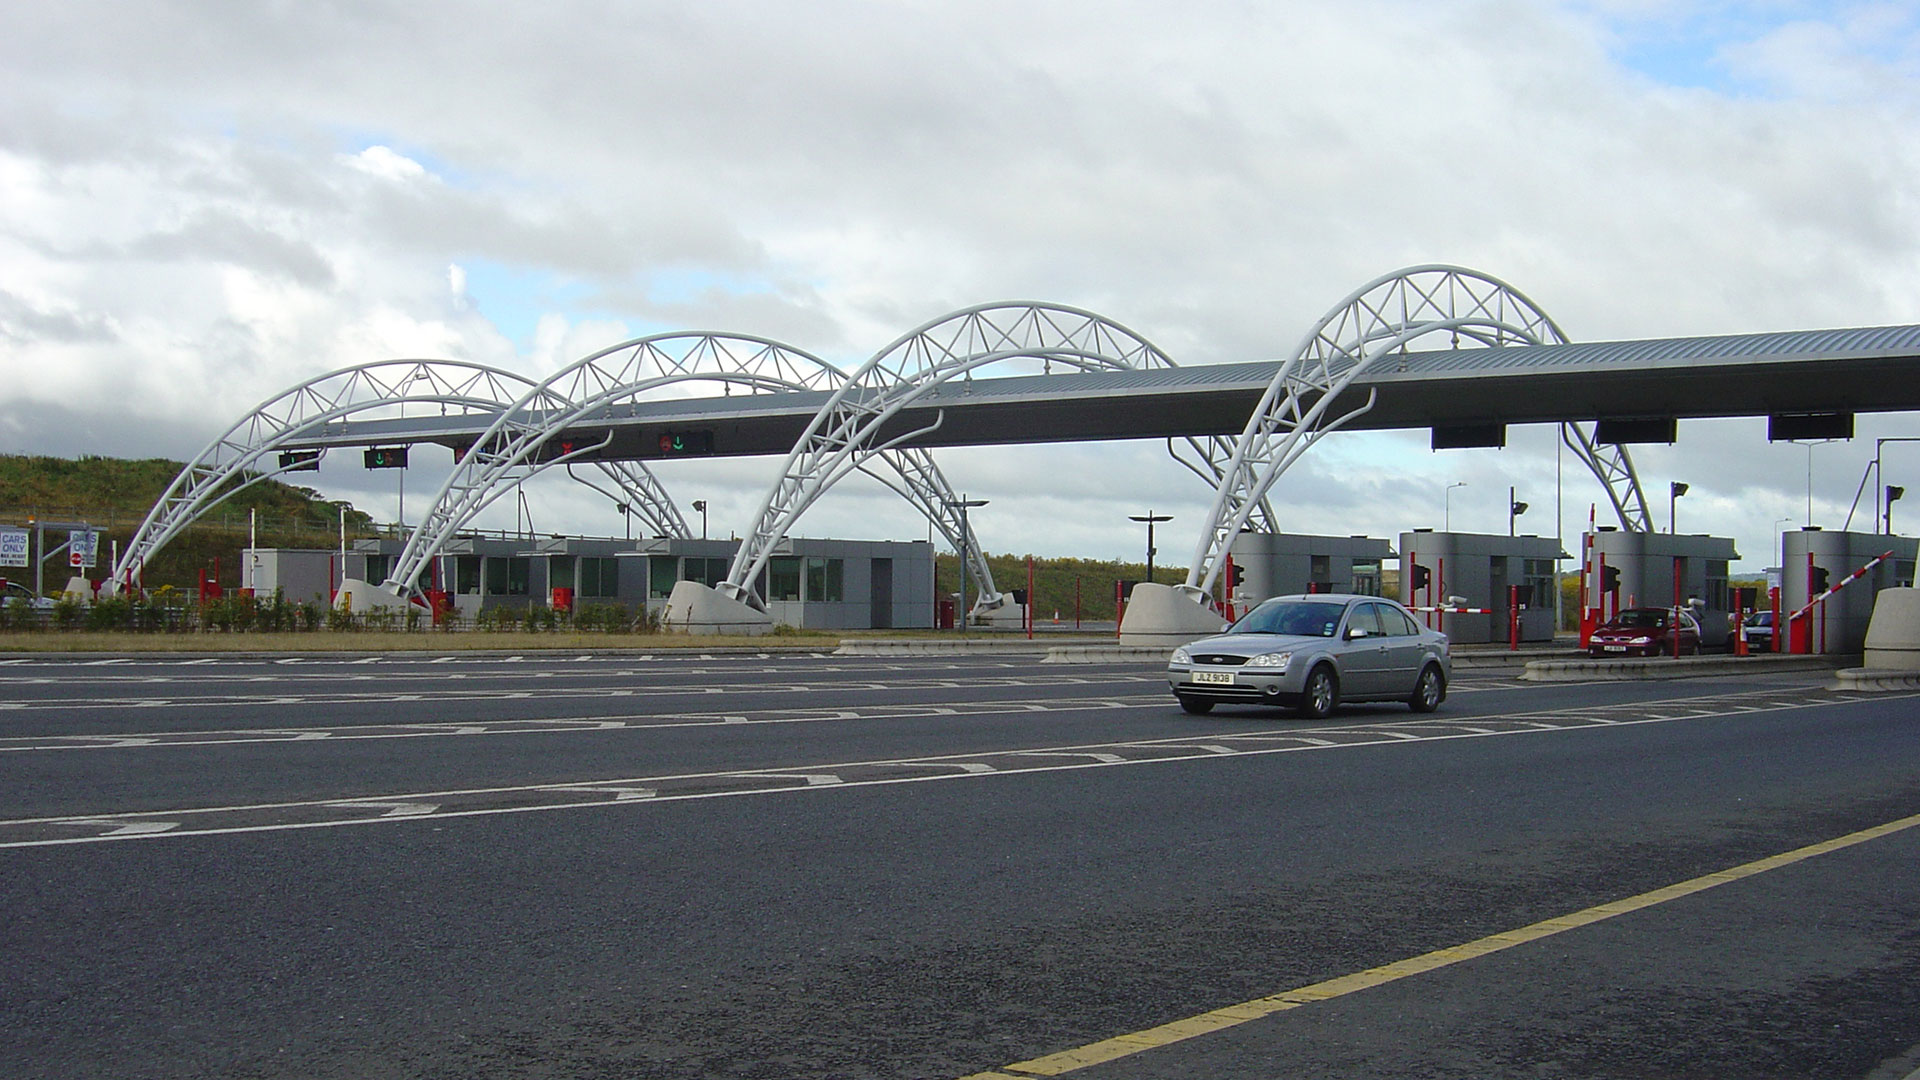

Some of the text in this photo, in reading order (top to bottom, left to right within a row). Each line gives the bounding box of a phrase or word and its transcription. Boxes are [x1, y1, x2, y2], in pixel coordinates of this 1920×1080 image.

[2, 535, 26, 544] CARS
[3, 544, 25, 553] ONLY
[1197, 673, 1211, 682] JLZ
